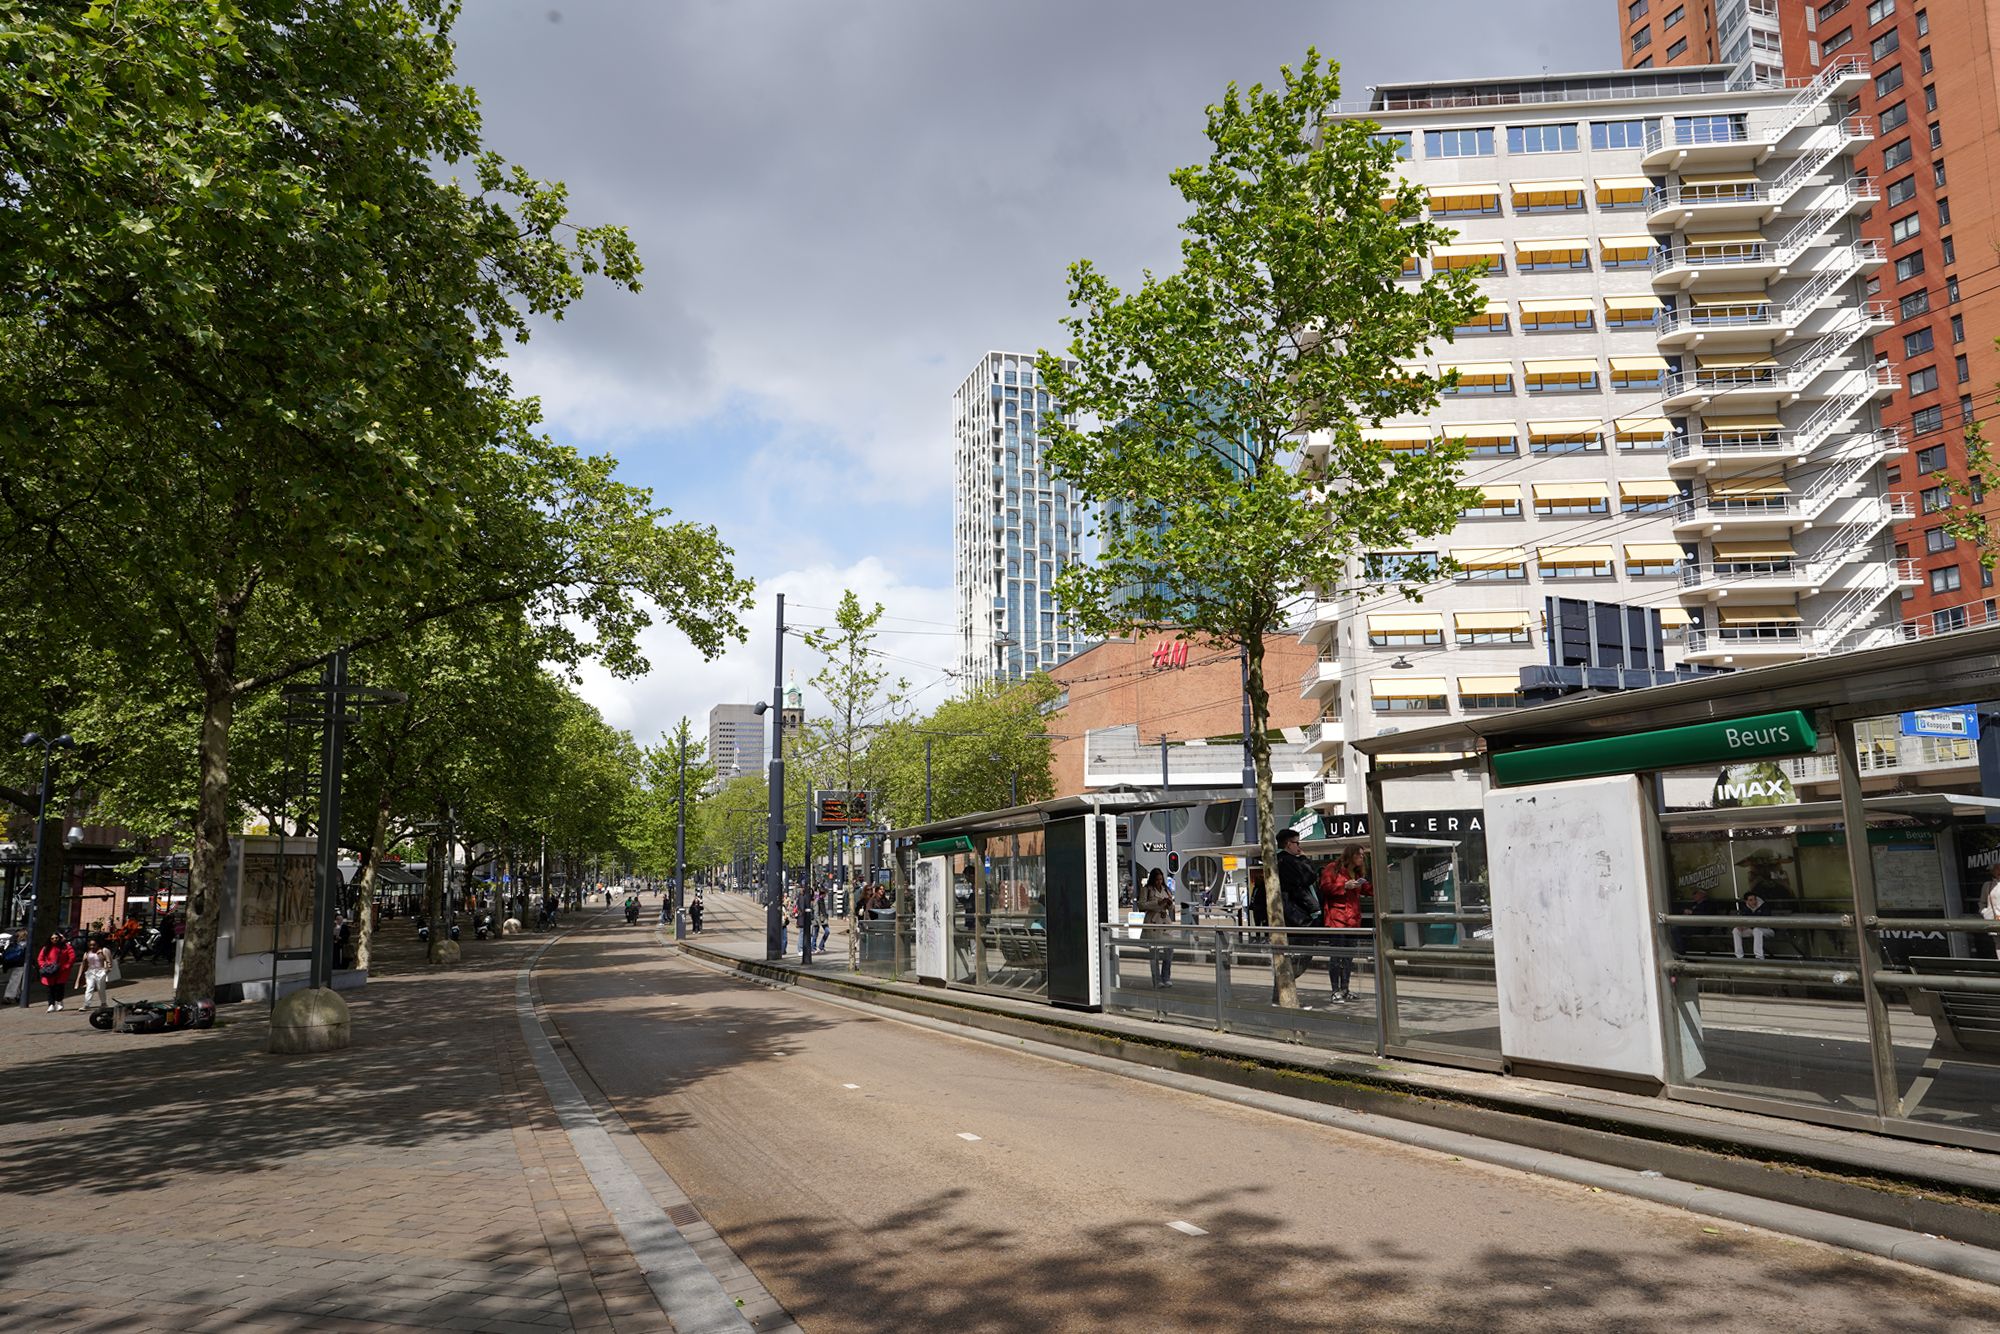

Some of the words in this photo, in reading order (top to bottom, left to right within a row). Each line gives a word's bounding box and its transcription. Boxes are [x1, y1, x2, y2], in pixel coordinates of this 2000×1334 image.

[1152, 640, 1188, 669] H&M
[1725, 726, 1790, 748] Beurs
[1717, 780, 1786, 800] IMAX
[1428, 817, 1482, 831] ERA
[1906, 831, 1932, 840] Beurs
